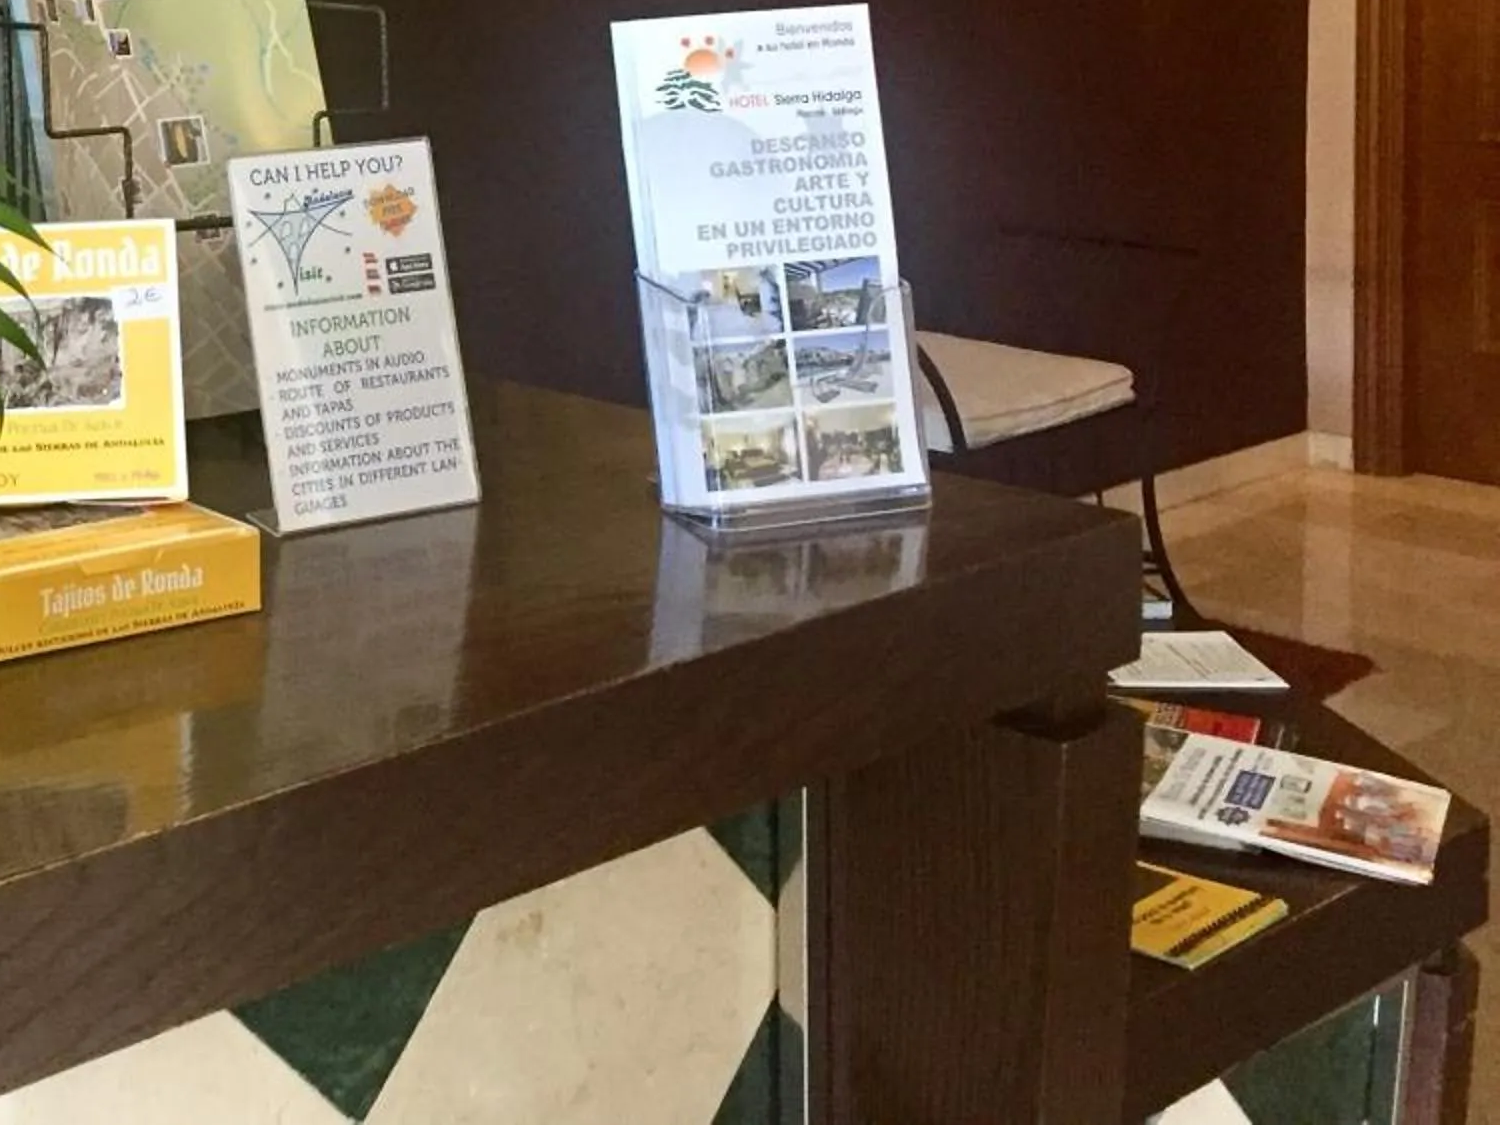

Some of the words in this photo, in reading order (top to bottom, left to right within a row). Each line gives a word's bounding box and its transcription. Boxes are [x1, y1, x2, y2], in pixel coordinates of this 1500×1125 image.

[729, 91, 769, 109] HOTEL
[774, 92, 810, 106] Sierra
[812, 89, 862, 104] Hidalga
[750, 130, 866, 155] DESCANSO
[250, 166, 290, 187] CAN
[294, 166, 302, 182] I
[304, 159, 350, 181] HELP
[355, 154, 403, 176] YOU?
[794, 172, 850, 192] ARTE
[856, 171, 870, 187] Y
[773, 190, 874, 215] CULTURA
[697, 222, 727, 242] EN
[734, 220, 766, 238] UN
[773, 211, 876, 235] ENTORNO
[3, 241, 42, 282] de
[51, 235, 161, 283] Ronda
[726, 230, 878, 260] PRIVILEGIADO
[290, 306, 411, 339] INFORMATION
[323, 334, 381, 359] ABOUT
[276, 361, 363, 384] MONUMENTS
[366, 357, 381, 371] IN
[384, 350, 425, 369] AUDIO
[278, 383, 323, 403] ROUTE
[333, 379, 352, 395] OF
[361, 365, 451, 391] RESTAURANTS
[282, 405, 311, 422] AND
[314, 398, 354, 416] TAPAS
[283, 415, 361, 441] DISCOUNTS
[364, 412, 382, 428] OF
[386, 401, 456, 424] PRODUCTS
[287, 442, 316, 460] AND
[319, 432, 380, 454] SERVICES
[289, 450, 382, 478] INFORMATION
[386, 442, 430, 462] ABOUT
[436, 437, 461, 453] THE
[291, 478, 333, 497] CITIES
[339, 474, 354, 490] IN
[358, 463, 427, 486] DIFFERENT
[293, 494, 348, 516] GUAGES
[39, 583, 106, 618] Tajitos
[112, 574, 136, 602] de
[141, 563, 204, 597] Ronda
